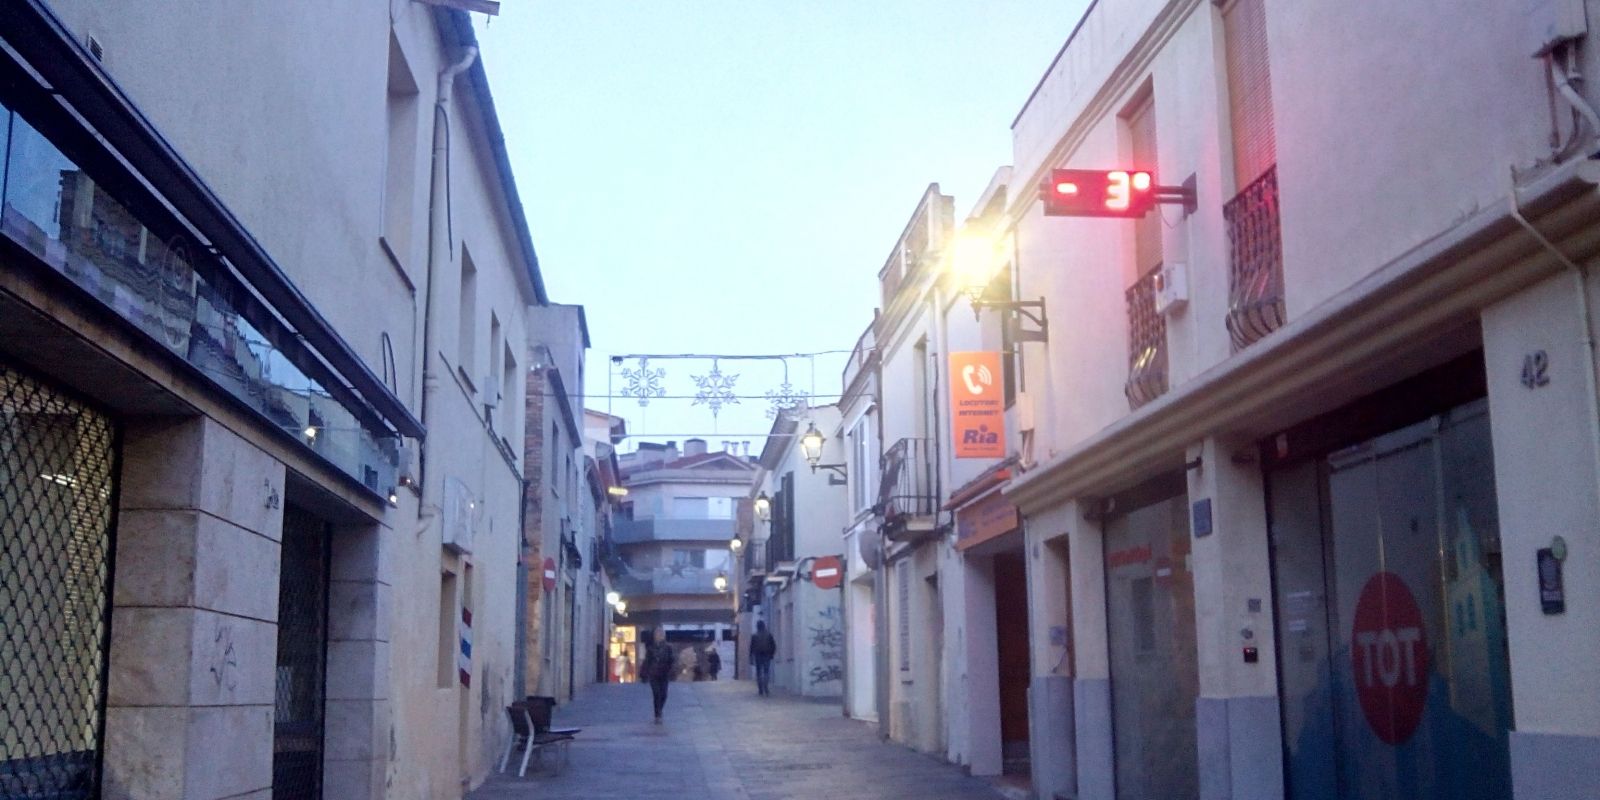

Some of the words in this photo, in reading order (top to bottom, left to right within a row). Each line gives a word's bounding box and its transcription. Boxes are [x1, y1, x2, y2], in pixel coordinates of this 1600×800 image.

[1520, 350, 1550, 390] 42
[963, 424, 998, 444] Ria
[1357, 628, 1420, 687] TOT
